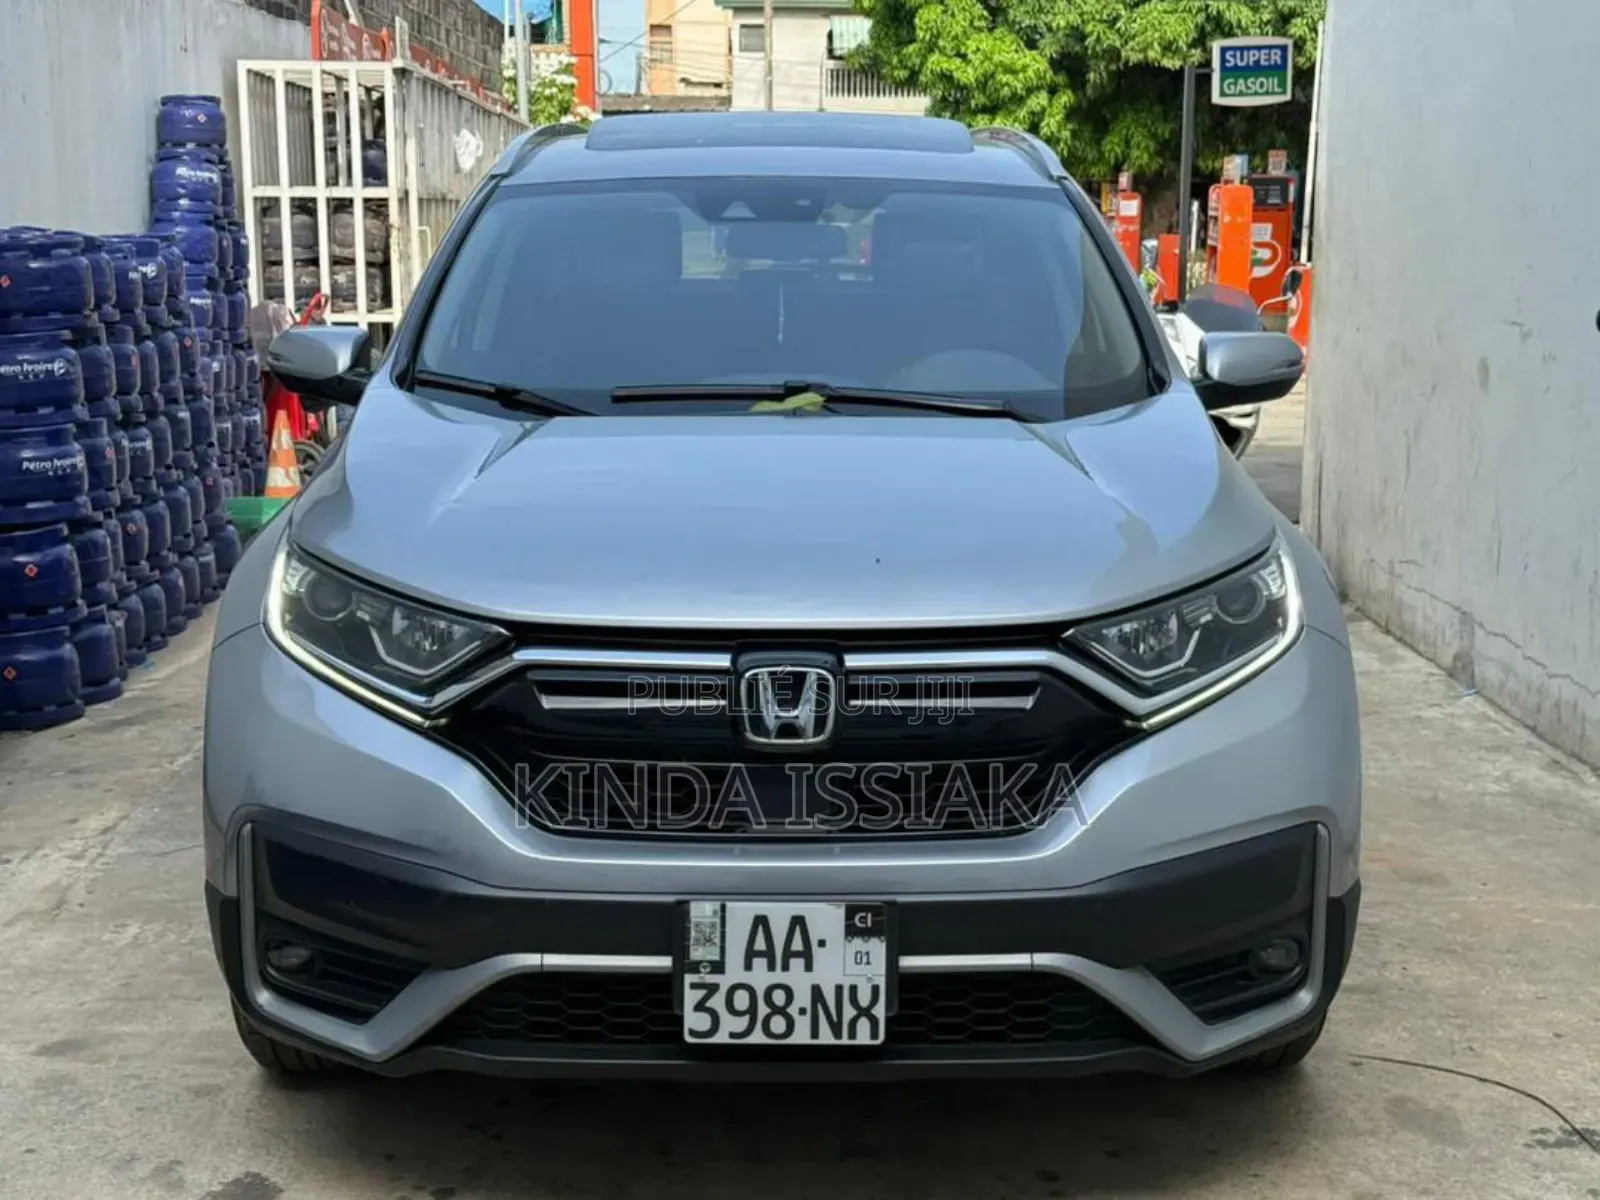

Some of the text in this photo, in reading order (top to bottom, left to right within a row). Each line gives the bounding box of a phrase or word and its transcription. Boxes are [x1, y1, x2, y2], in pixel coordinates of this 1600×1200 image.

[1224, 48, 1282, 68] SUPER
[1223, 76, 1283, 95] GASOIL
[854, 912, 872, 928] CI
[854, 951, 871, 966] 01
